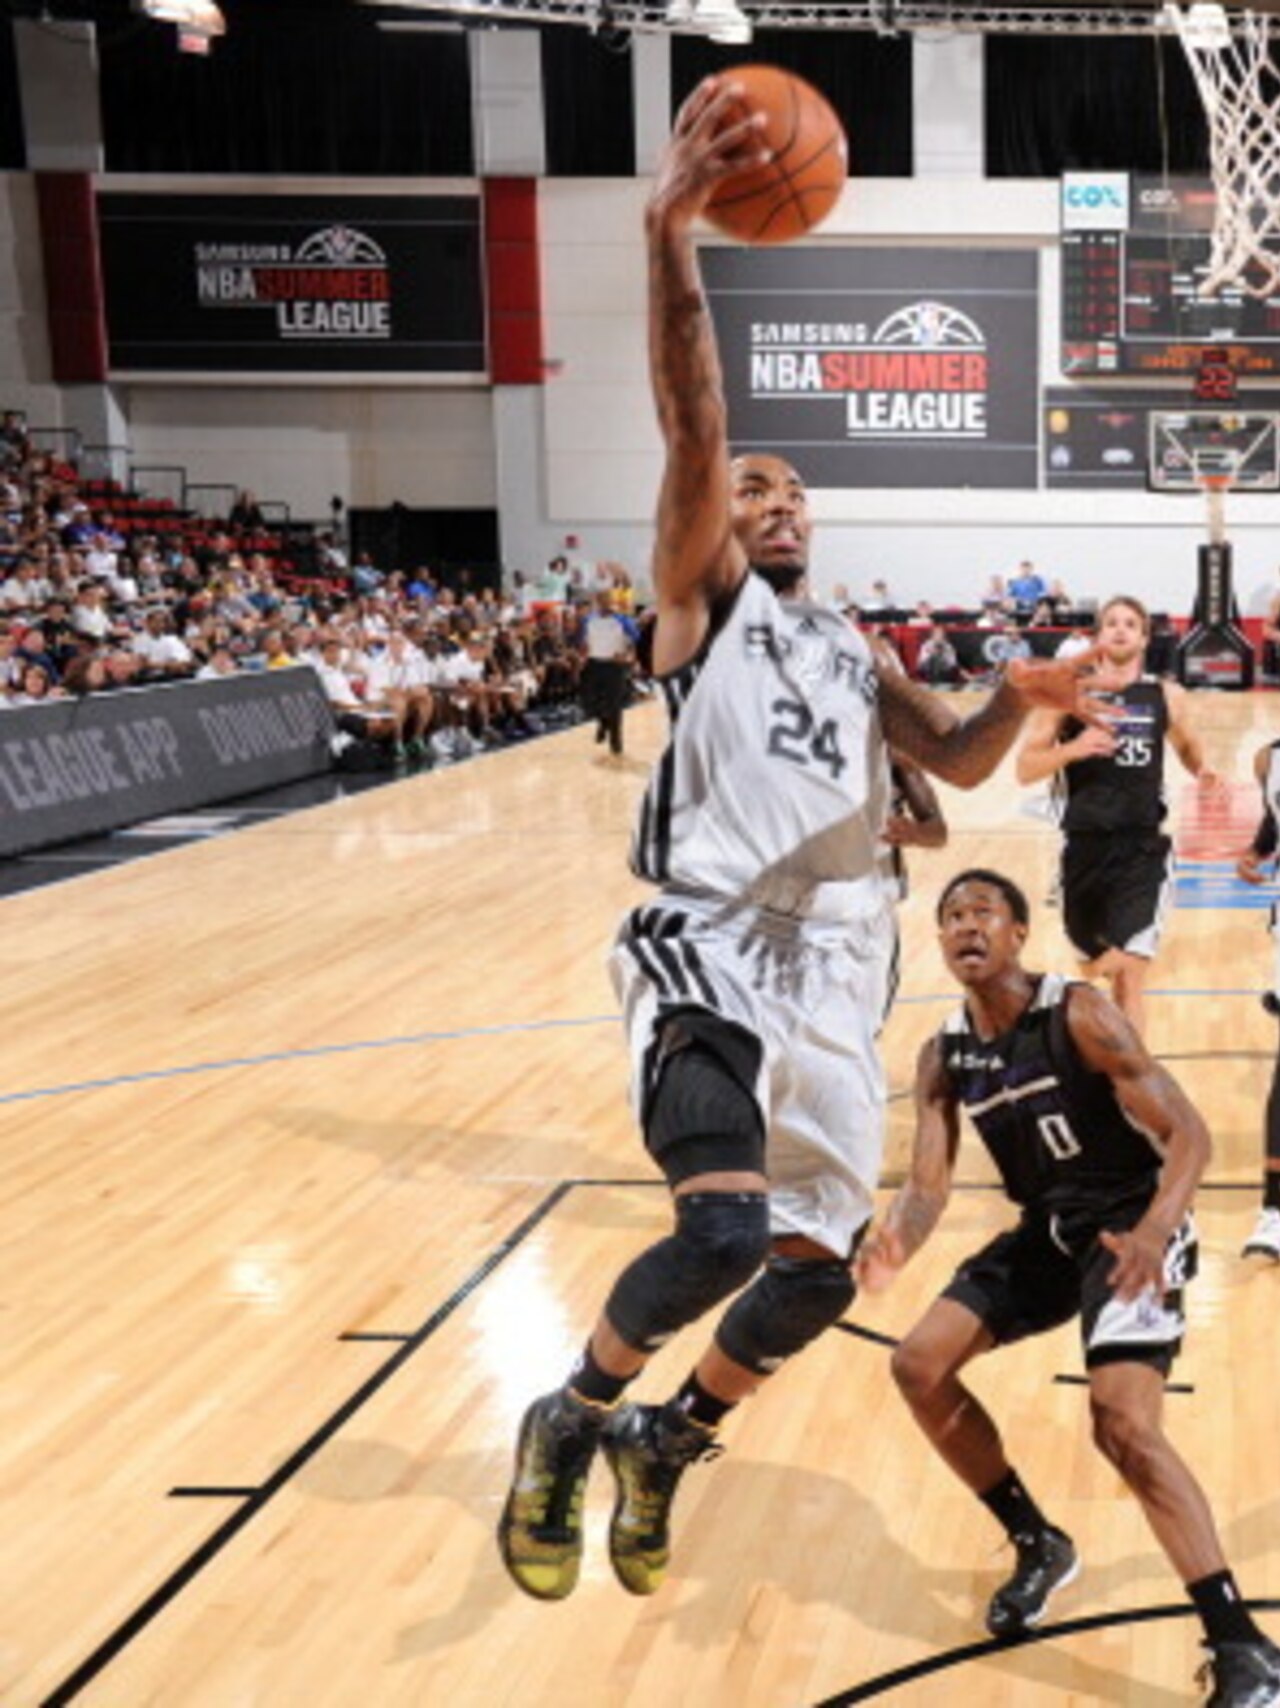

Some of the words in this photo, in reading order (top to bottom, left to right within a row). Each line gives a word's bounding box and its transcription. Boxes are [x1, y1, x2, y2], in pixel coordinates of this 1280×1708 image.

[279, 301, 390, 331] LEAGUE
[751, 323, 867, 343] SAMSUNG
[847, 393, 987, 429] LEAGUE
[767, 699, 847, 779] 24
[1114, 736, 1152, 767] 35
[2, 727, 129, 811] LEAGUE
[116, 717, 183, 784] APP
[1037, 1113, 1082, 1161] 0
